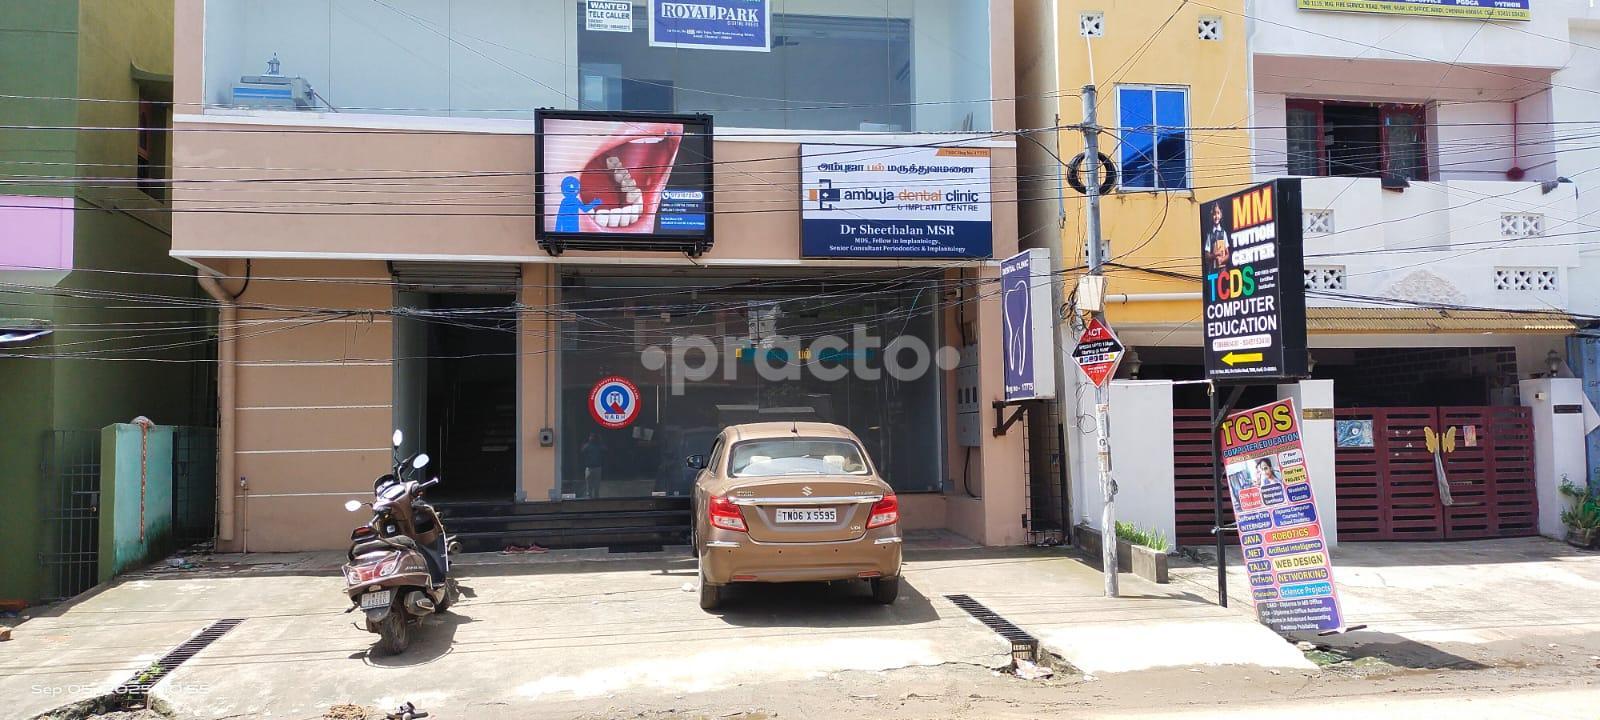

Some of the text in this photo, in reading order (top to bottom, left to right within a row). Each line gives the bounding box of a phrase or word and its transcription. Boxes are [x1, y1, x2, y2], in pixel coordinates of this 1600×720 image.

[590, 1, 628, 10] WANTED
[589, 10, 630, 20] TELE CALLER
[663, 4, 760, 22] ROYAL PARK
[844, 188, 979, 204] ambuja dental clinic
[945, 204, 978, 212] CENTRE
[1232, 187, 1274, 230] MM
[840, 223, 955, 236] Dr Sheethalan MSR
[1231, 221, 1275, 248] TUITION
[1231, 242, 1276, 267] CENTER
[1002, 259, 1029, 275] DENTAL CLINIC
[1207, 265, 1255, 302] TCDS
[1207, 295, 1275, 320] COMPUTER
[1088, 327, 1102, 337] ACT
[1207, 314, 1277, 338] EDUCATION
[1221, 404, 1294, 446] TCDS
[1223, 440, 1258, 458] COMPUTER
[1259, 432, 1300, 449] EDUCATION
[782, 511, 835, 521] TN06 X 5595
[1244, 534, 1261, 545] JAVA
[1272, 528, 1309, 541] ROBOTICS
[1268, 545, 1290, 554] Artificial
[1249, 561, 1269, 571] TALLY
[1275, 554, 1323, 569] WEB DESIGN
[1251, 574, 1273, 583] PYTHON
[1278, 569, 1327, 582] NETWORKING
[1281, 584, 1331, 596] Science Projects
